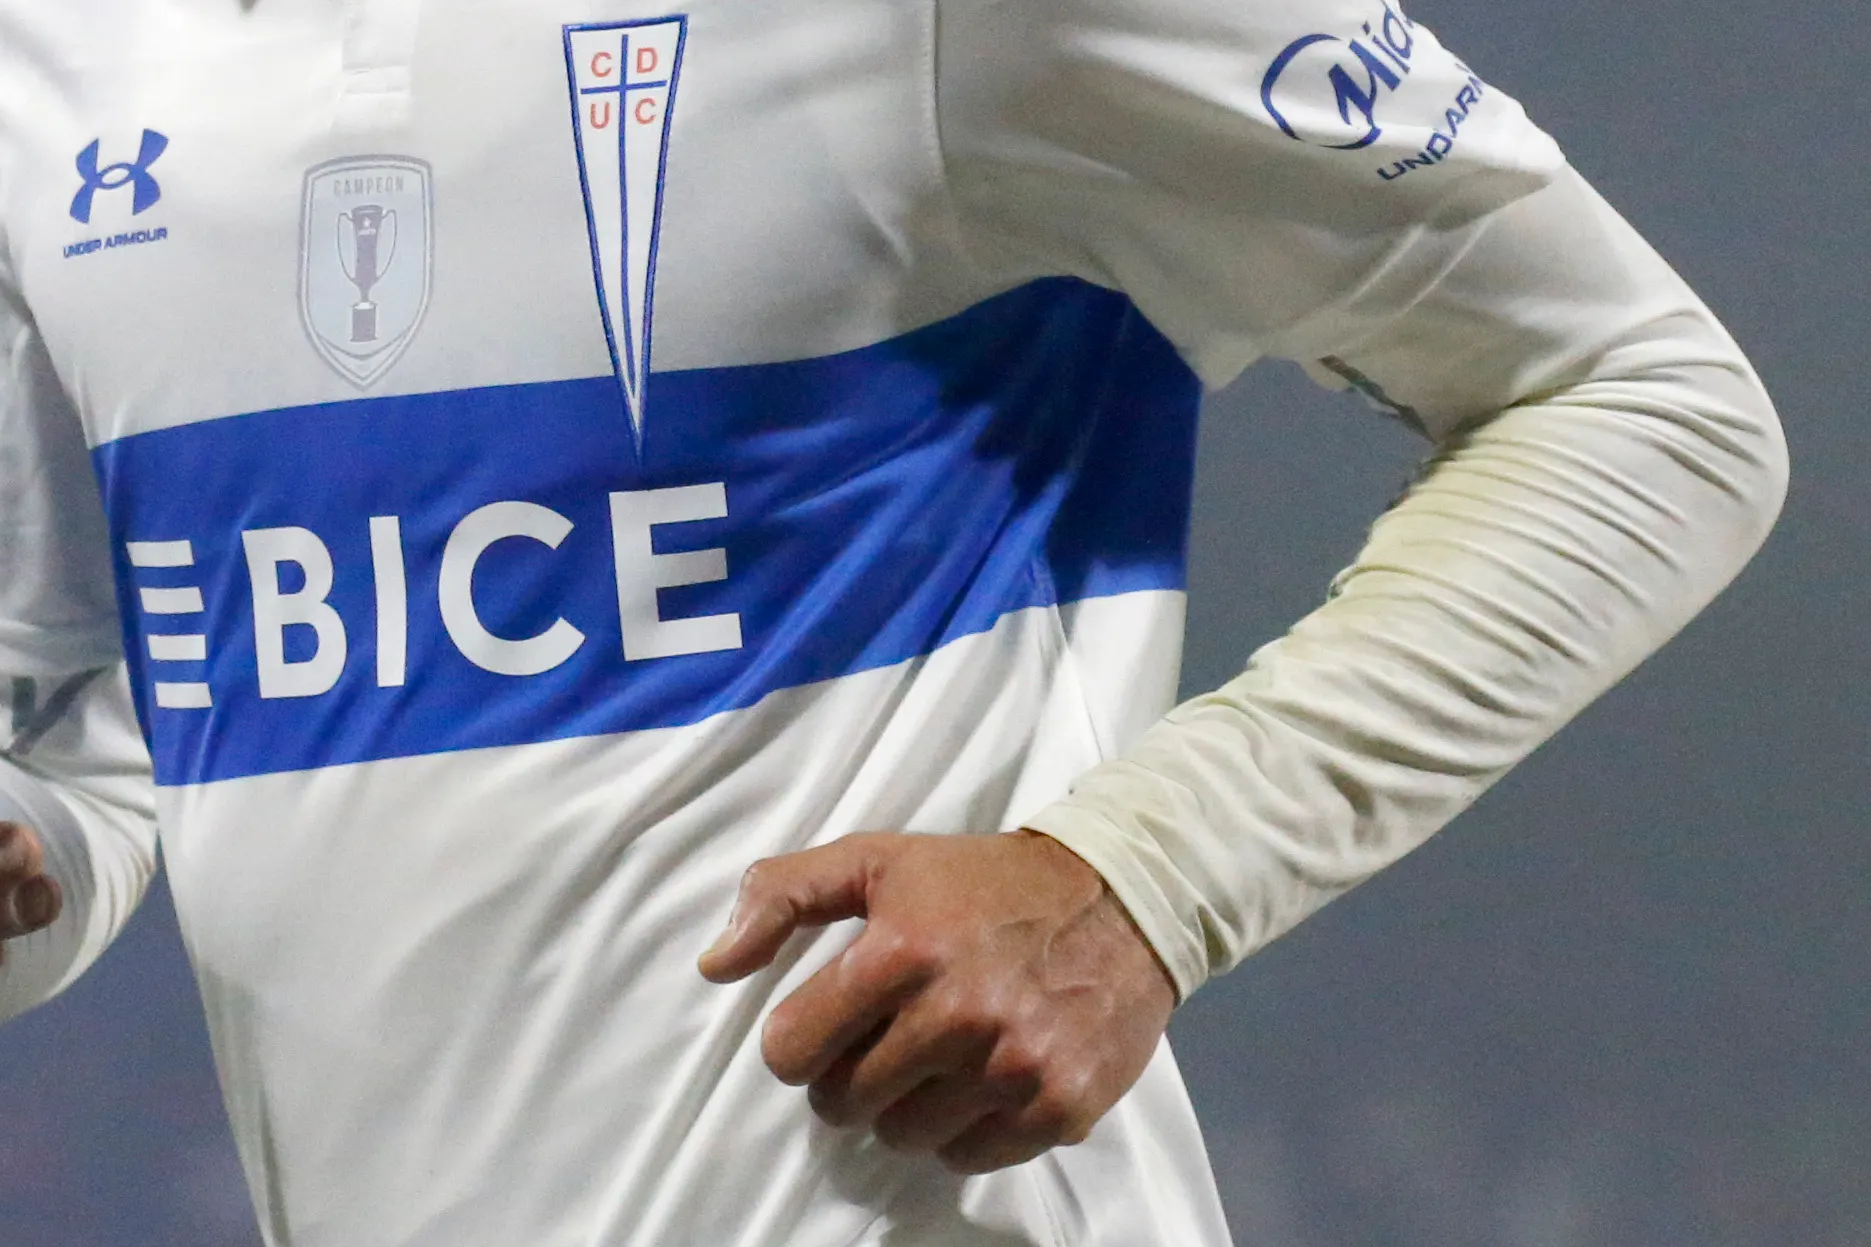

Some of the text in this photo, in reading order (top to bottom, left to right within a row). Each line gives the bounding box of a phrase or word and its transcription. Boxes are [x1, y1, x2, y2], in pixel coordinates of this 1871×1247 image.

[63, 227, 168, 258] UNDER ARMOUR
[242, 481, 743, 699] BICE
